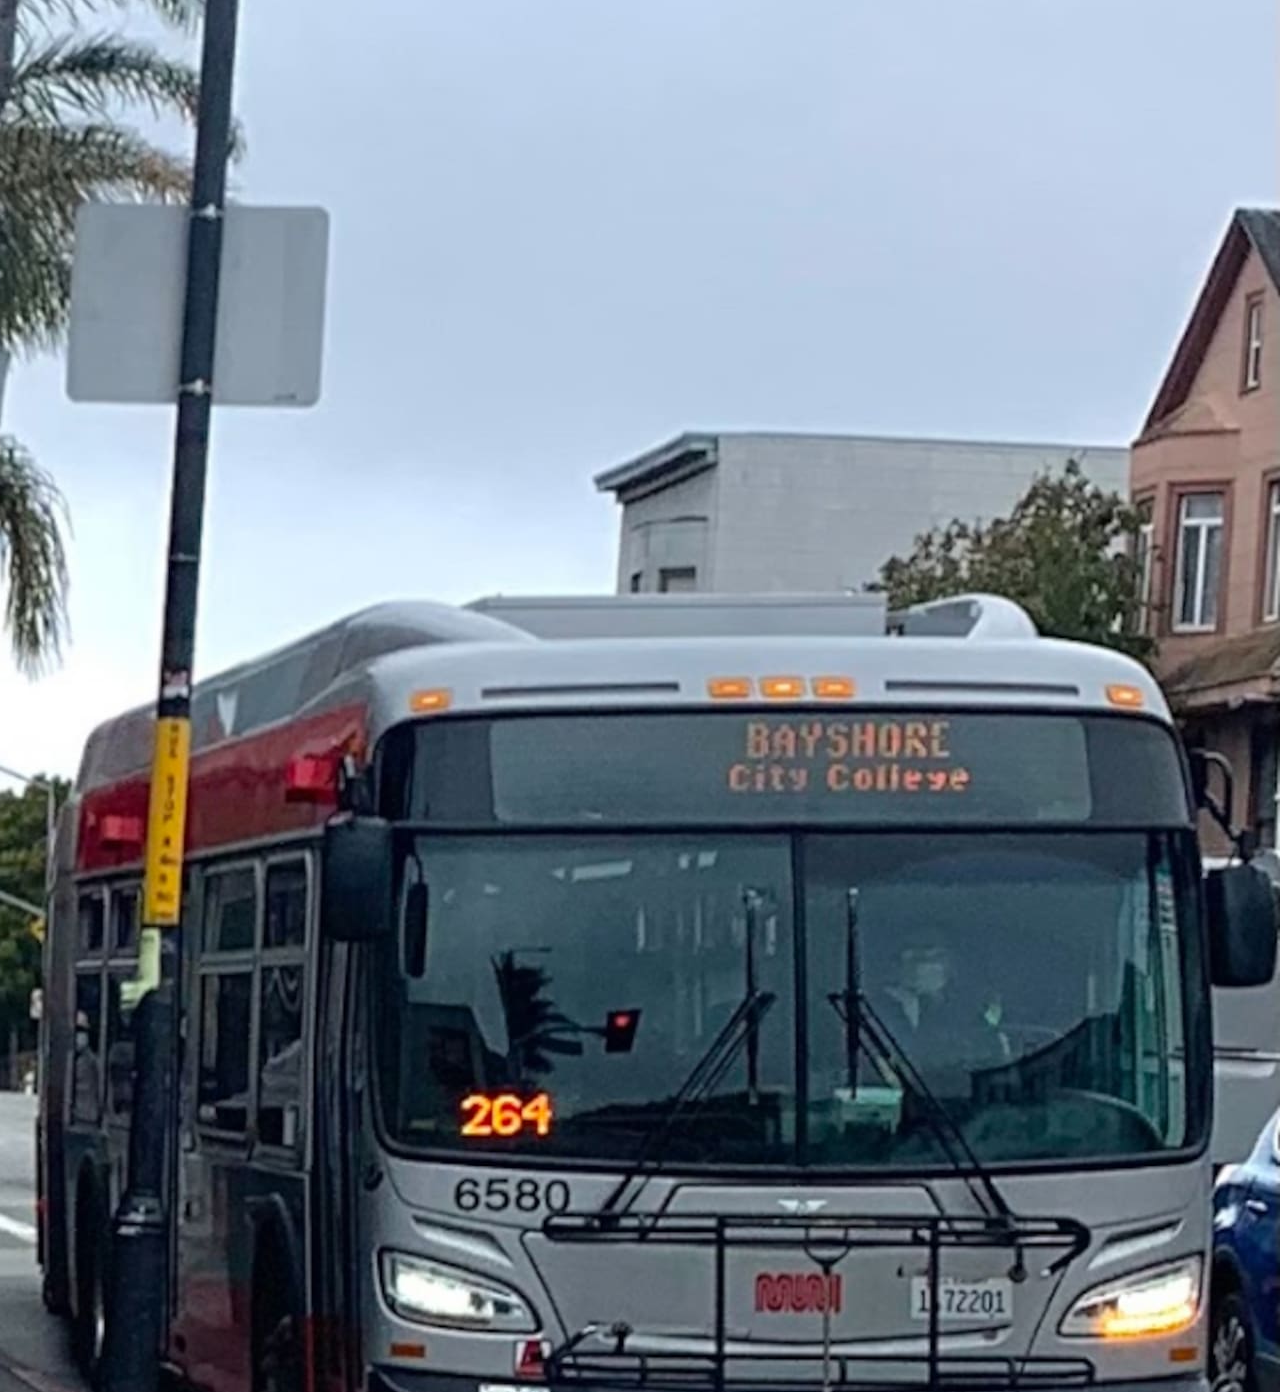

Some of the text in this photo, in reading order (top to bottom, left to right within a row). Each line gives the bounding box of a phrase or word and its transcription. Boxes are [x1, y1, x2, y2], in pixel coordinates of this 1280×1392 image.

[746, 721, 951, 758] BAYSHORE
[728, 763, 970, 792] City College
[460, 1093, 553, 1136] 264
[454, 1178, 570, 1213] 6580
[919, 1289, 1006, 1314] 172201
